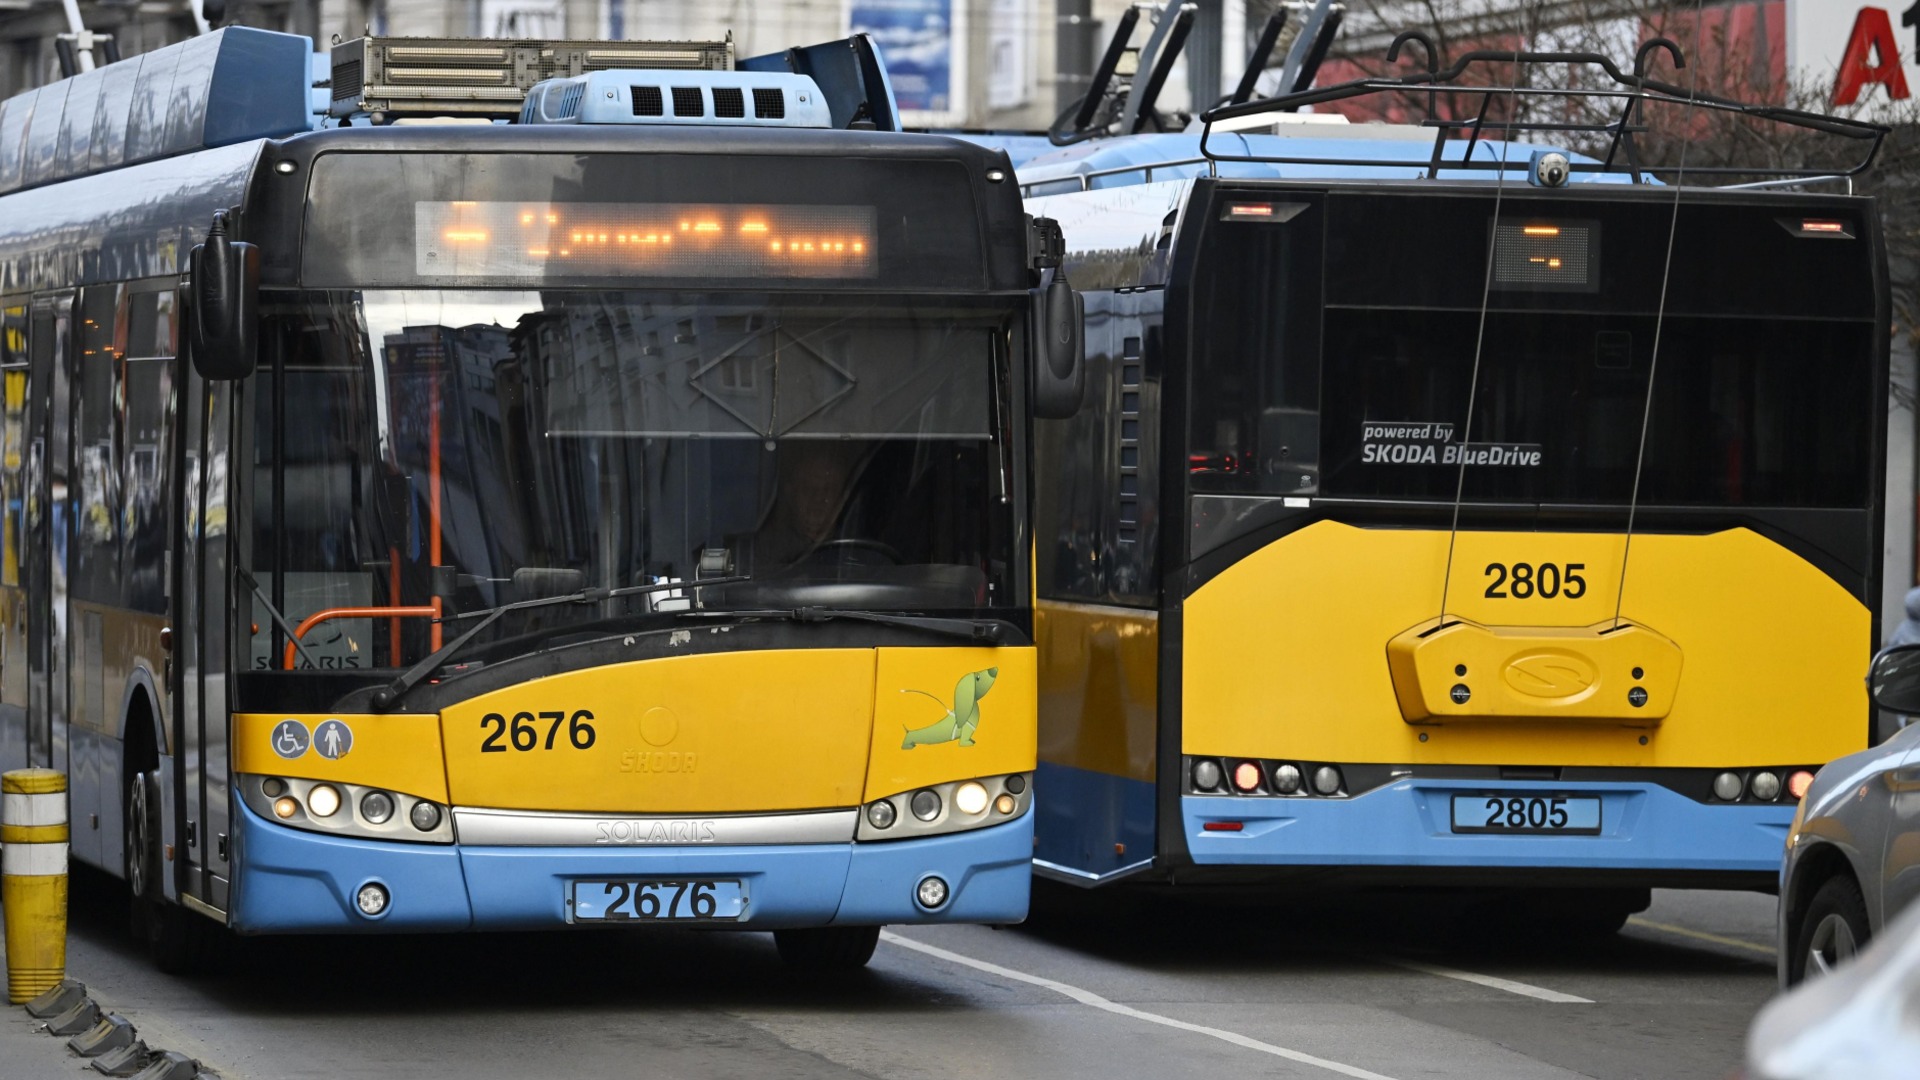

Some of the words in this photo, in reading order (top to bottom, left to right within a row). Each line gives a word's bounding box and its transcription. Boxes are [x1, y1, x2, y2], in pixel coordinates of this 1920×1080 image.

[1363, 425, 1431, 441] powered
[1434, 426, 1453, 443] by
[1362, 444, 1436, 464] SKODA
[1442, 446, 1541, 466] BlueDrive
[1484, 562, 1587, 599] 2805
[256, 656, 359, 670] SARIS
[480, 710, 596, 752] 2676
[1485, 798, 1568, 828] 2805
[595, 821, 715, 843] SOLARIS
[604, 881, 716, 920] 2676
